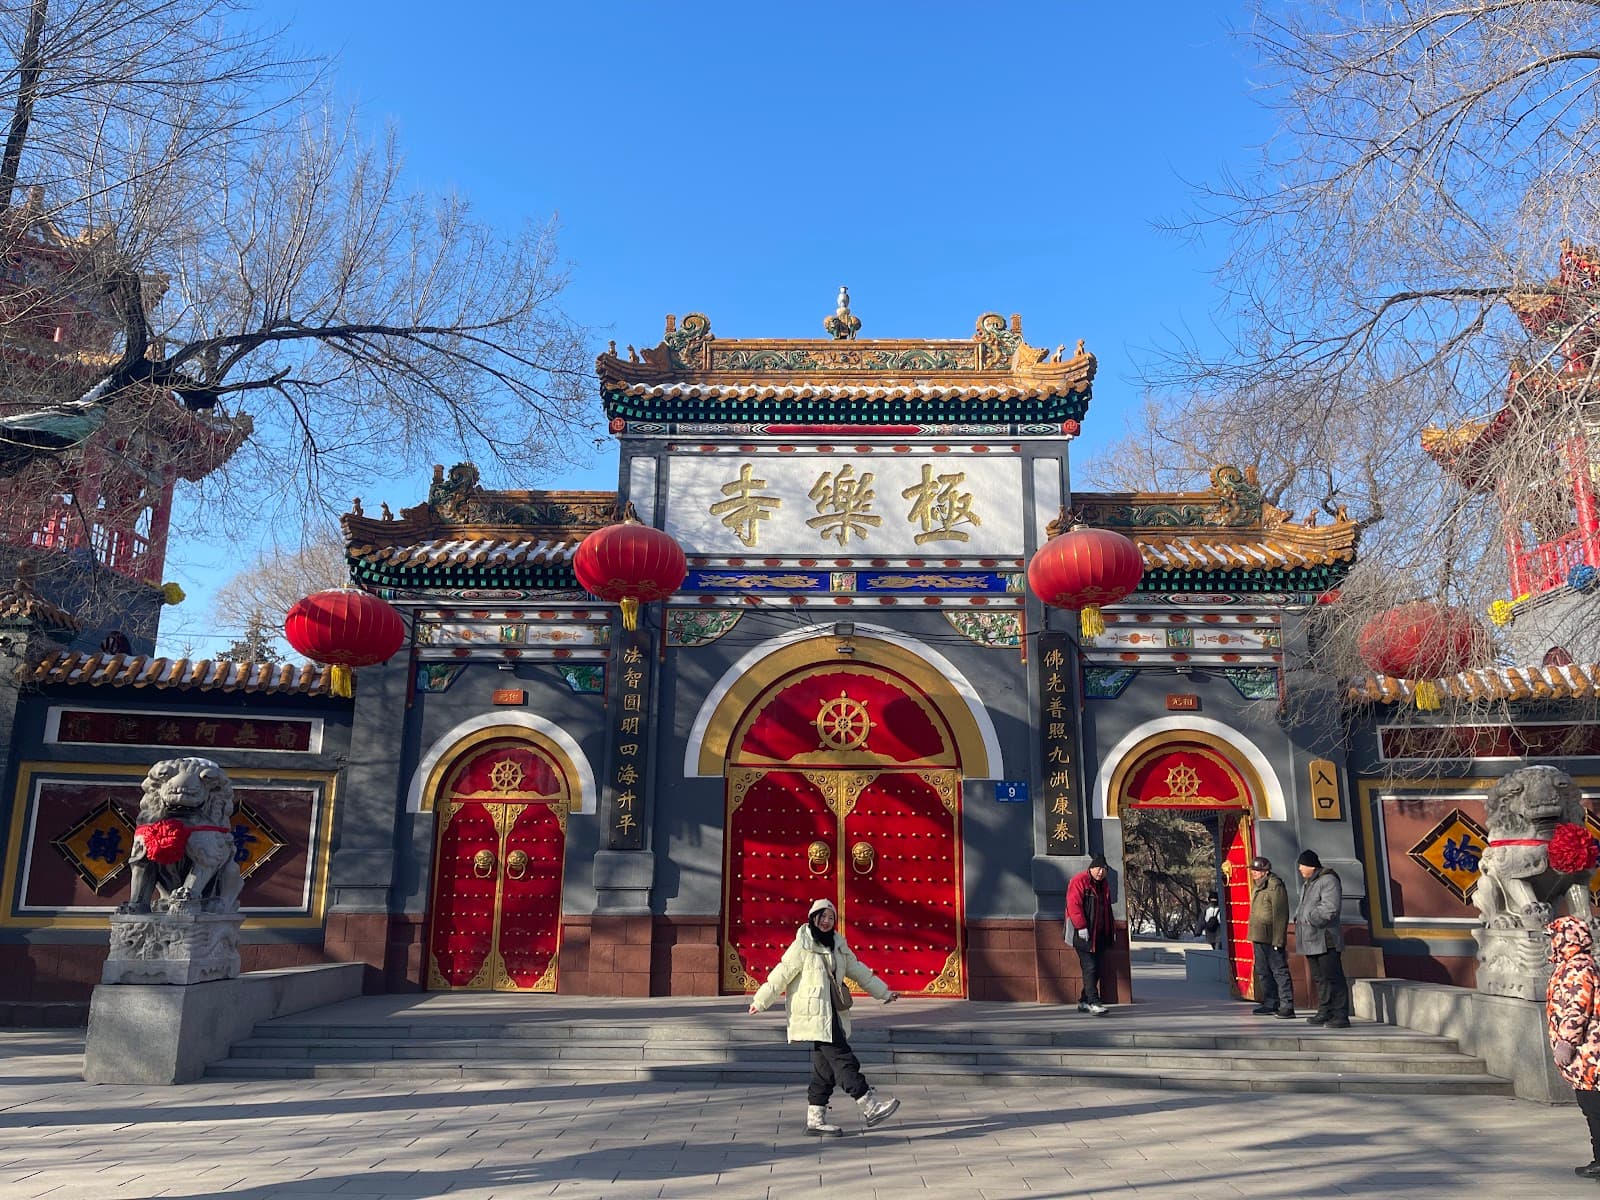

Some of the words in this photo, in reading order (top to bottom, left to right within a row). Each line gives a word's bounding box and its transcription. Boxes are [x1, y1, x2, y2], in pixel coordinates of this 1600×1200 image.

[709, 463, 983, 547] 極樂寺
[615, 646, 643, 836] 法智圓明四海升平
[1043, 648, 1075, 842] 佛光普照九洲康泰
[1008, 786, 1016, 797] 9
[1315, 770, 1334, 808] 入口
